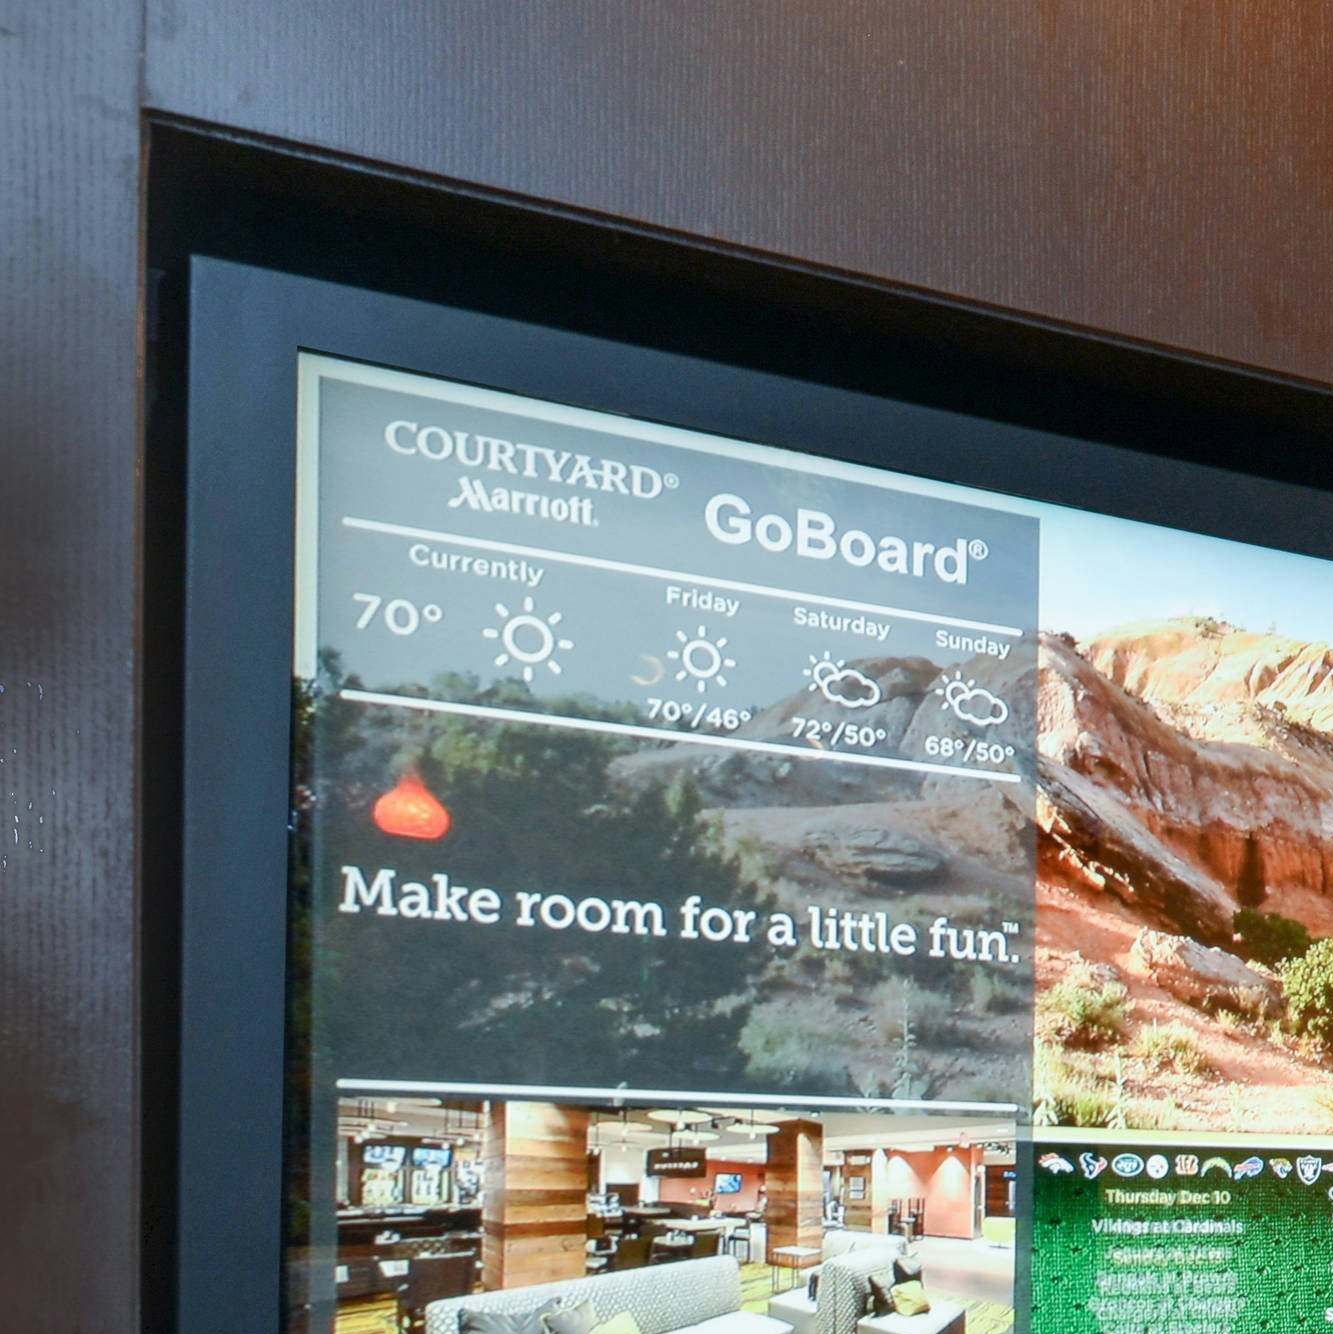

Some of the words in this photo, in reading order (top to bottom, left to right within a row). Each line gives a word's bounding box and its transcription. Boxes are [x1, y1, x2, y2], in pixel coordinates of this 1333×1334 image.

[409, 543, 544, 587] Currently
[352, 592, 443, 635] 70°
[666, 586, 740, 616] Friday
[793, 606, 891, 640] Saturday
[935, 629, 1011, 659] Sunday
[648, 698, 752, 730] 70°/46°
[791, 717, 887, 748] 72°/50°
[925, 735, 1015, 764] 68°/50°
[338, 866, 500, 924] Make
[515, 891, 667, 937] room
[680, 896, 755, 943] for
[767, 911, 796, 946] a
[808, 906, 916, 955] little
[1105, 1188, 1177, 1207] Thursday
[1178, 1190, 1211, 1205] Dec
[1214, 1190, 1231, 1205] 10
